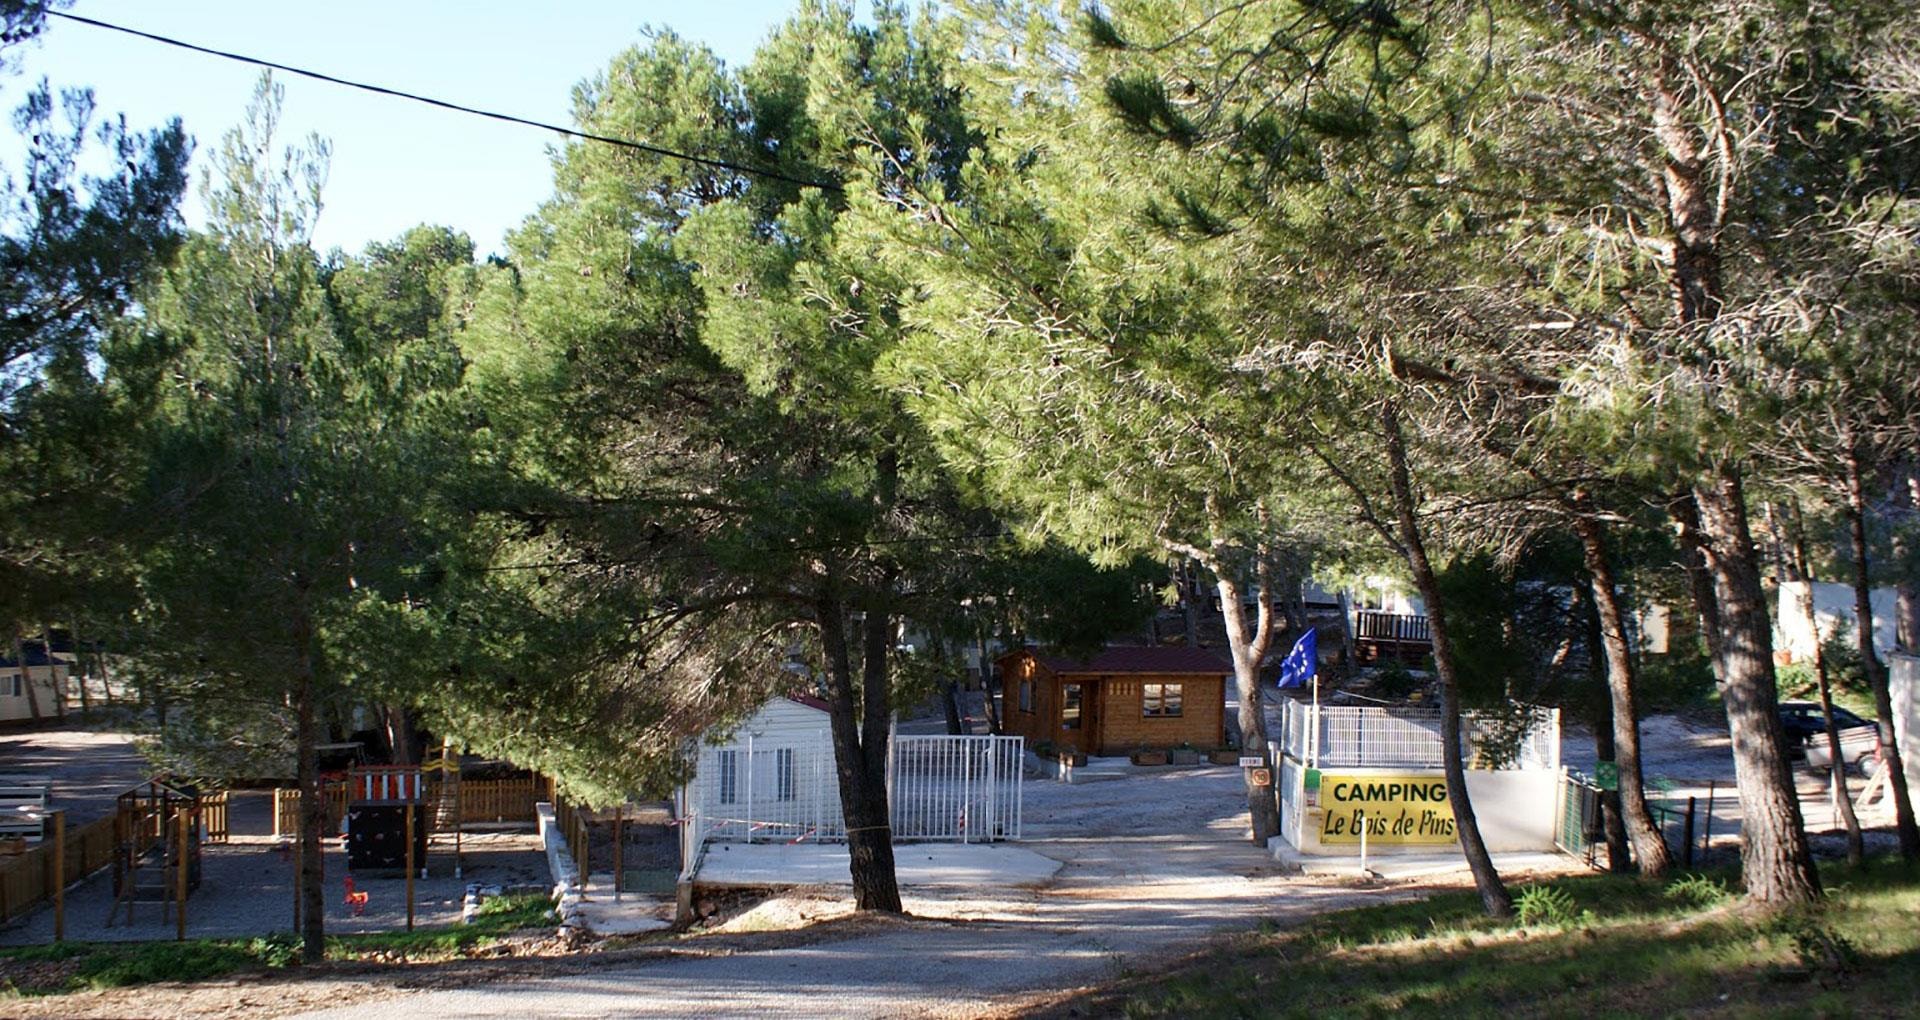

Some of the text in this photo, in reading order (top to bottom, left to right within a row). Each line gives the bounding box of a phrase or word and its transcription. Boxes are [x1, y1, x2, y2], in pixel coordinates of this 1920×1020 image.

[1334, 783, 1447, 802] CAMPING
[1324, 809, 1345, 835] Le
[1392, 808, 1414, 836] de
[1419, 809, 1455, 836] Pins
